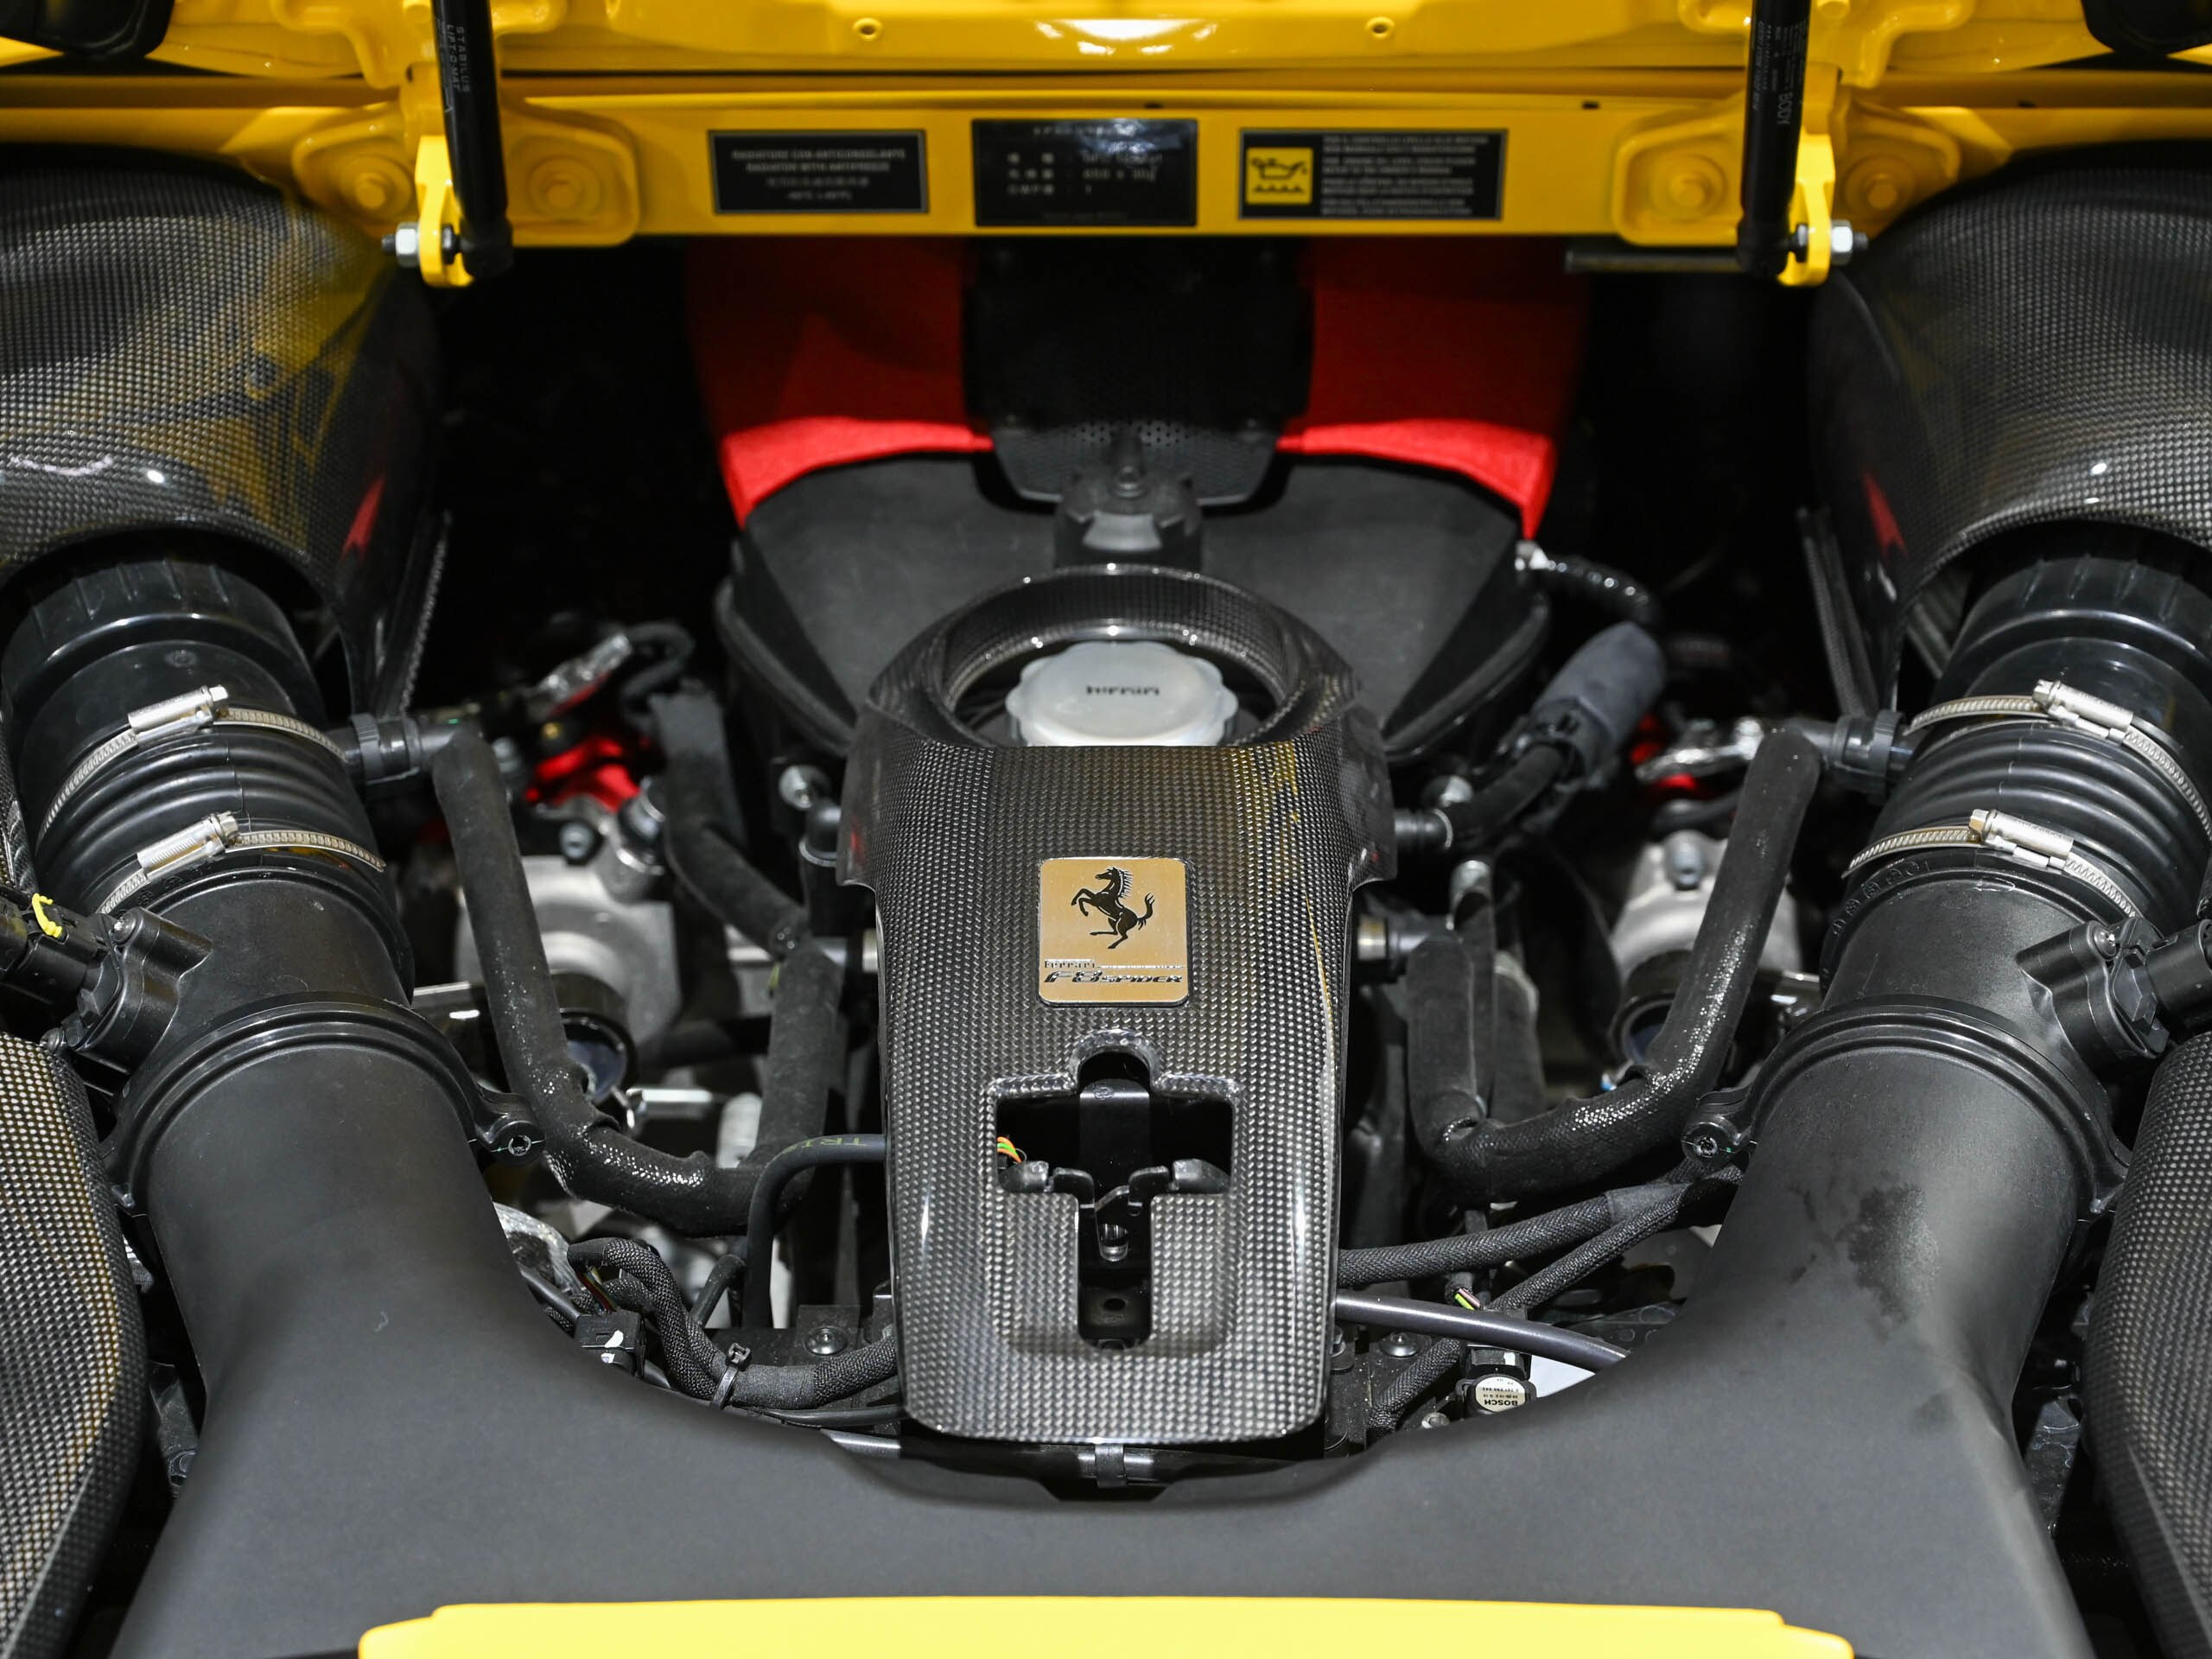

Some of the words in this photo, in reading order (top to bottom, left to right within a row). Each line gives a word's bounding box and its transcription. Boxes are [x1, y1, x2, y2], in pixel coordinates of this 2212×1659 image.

[456, 26, 471, 92] STABILUS
[1777, 92, 1794, 124] BODY
[1044, 958, 1096, 969] Ferrari
